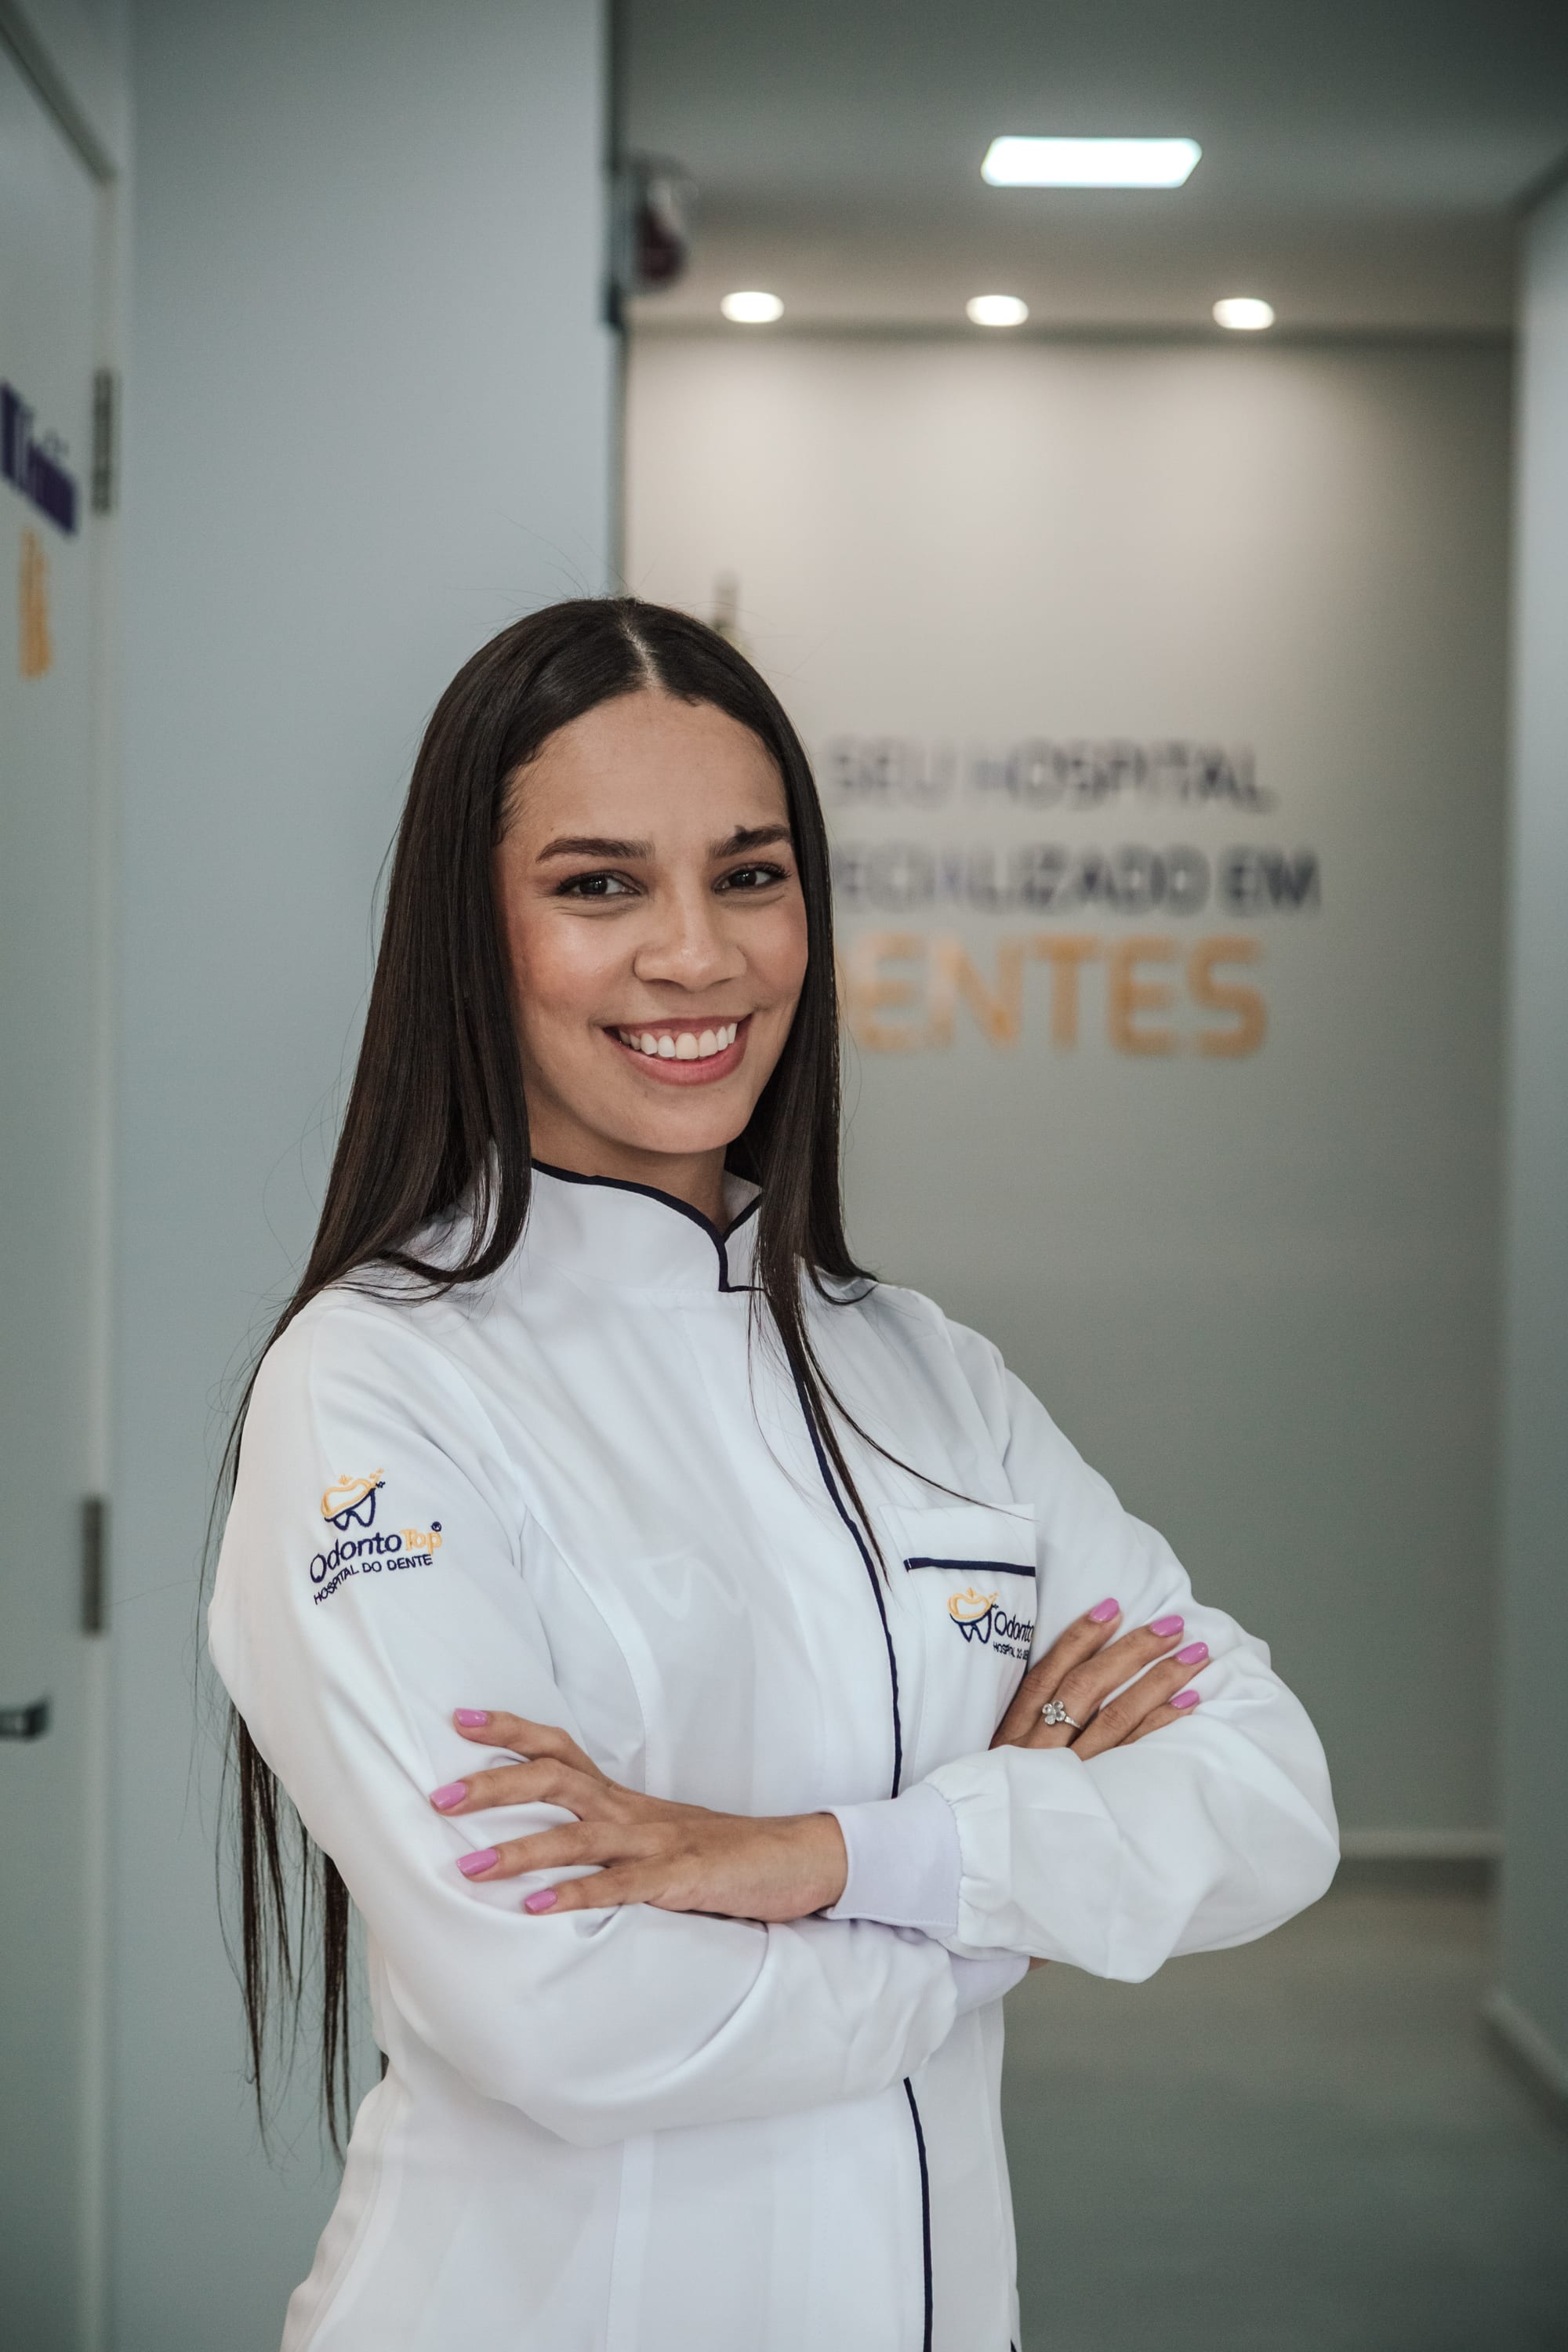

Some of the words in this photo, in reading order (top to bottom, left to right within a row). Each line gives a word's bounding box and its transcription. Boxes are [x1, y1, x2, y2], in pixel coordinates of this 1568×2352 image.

[1218, 843, 1323, 916] EM
[837, 931, 1269, 1057] ENTES
[314, 1565, 359, 1605] HOSPITAL
[362, 1561, 382, 1573] DO
[387, 1554, 433, 1571] DENTE
